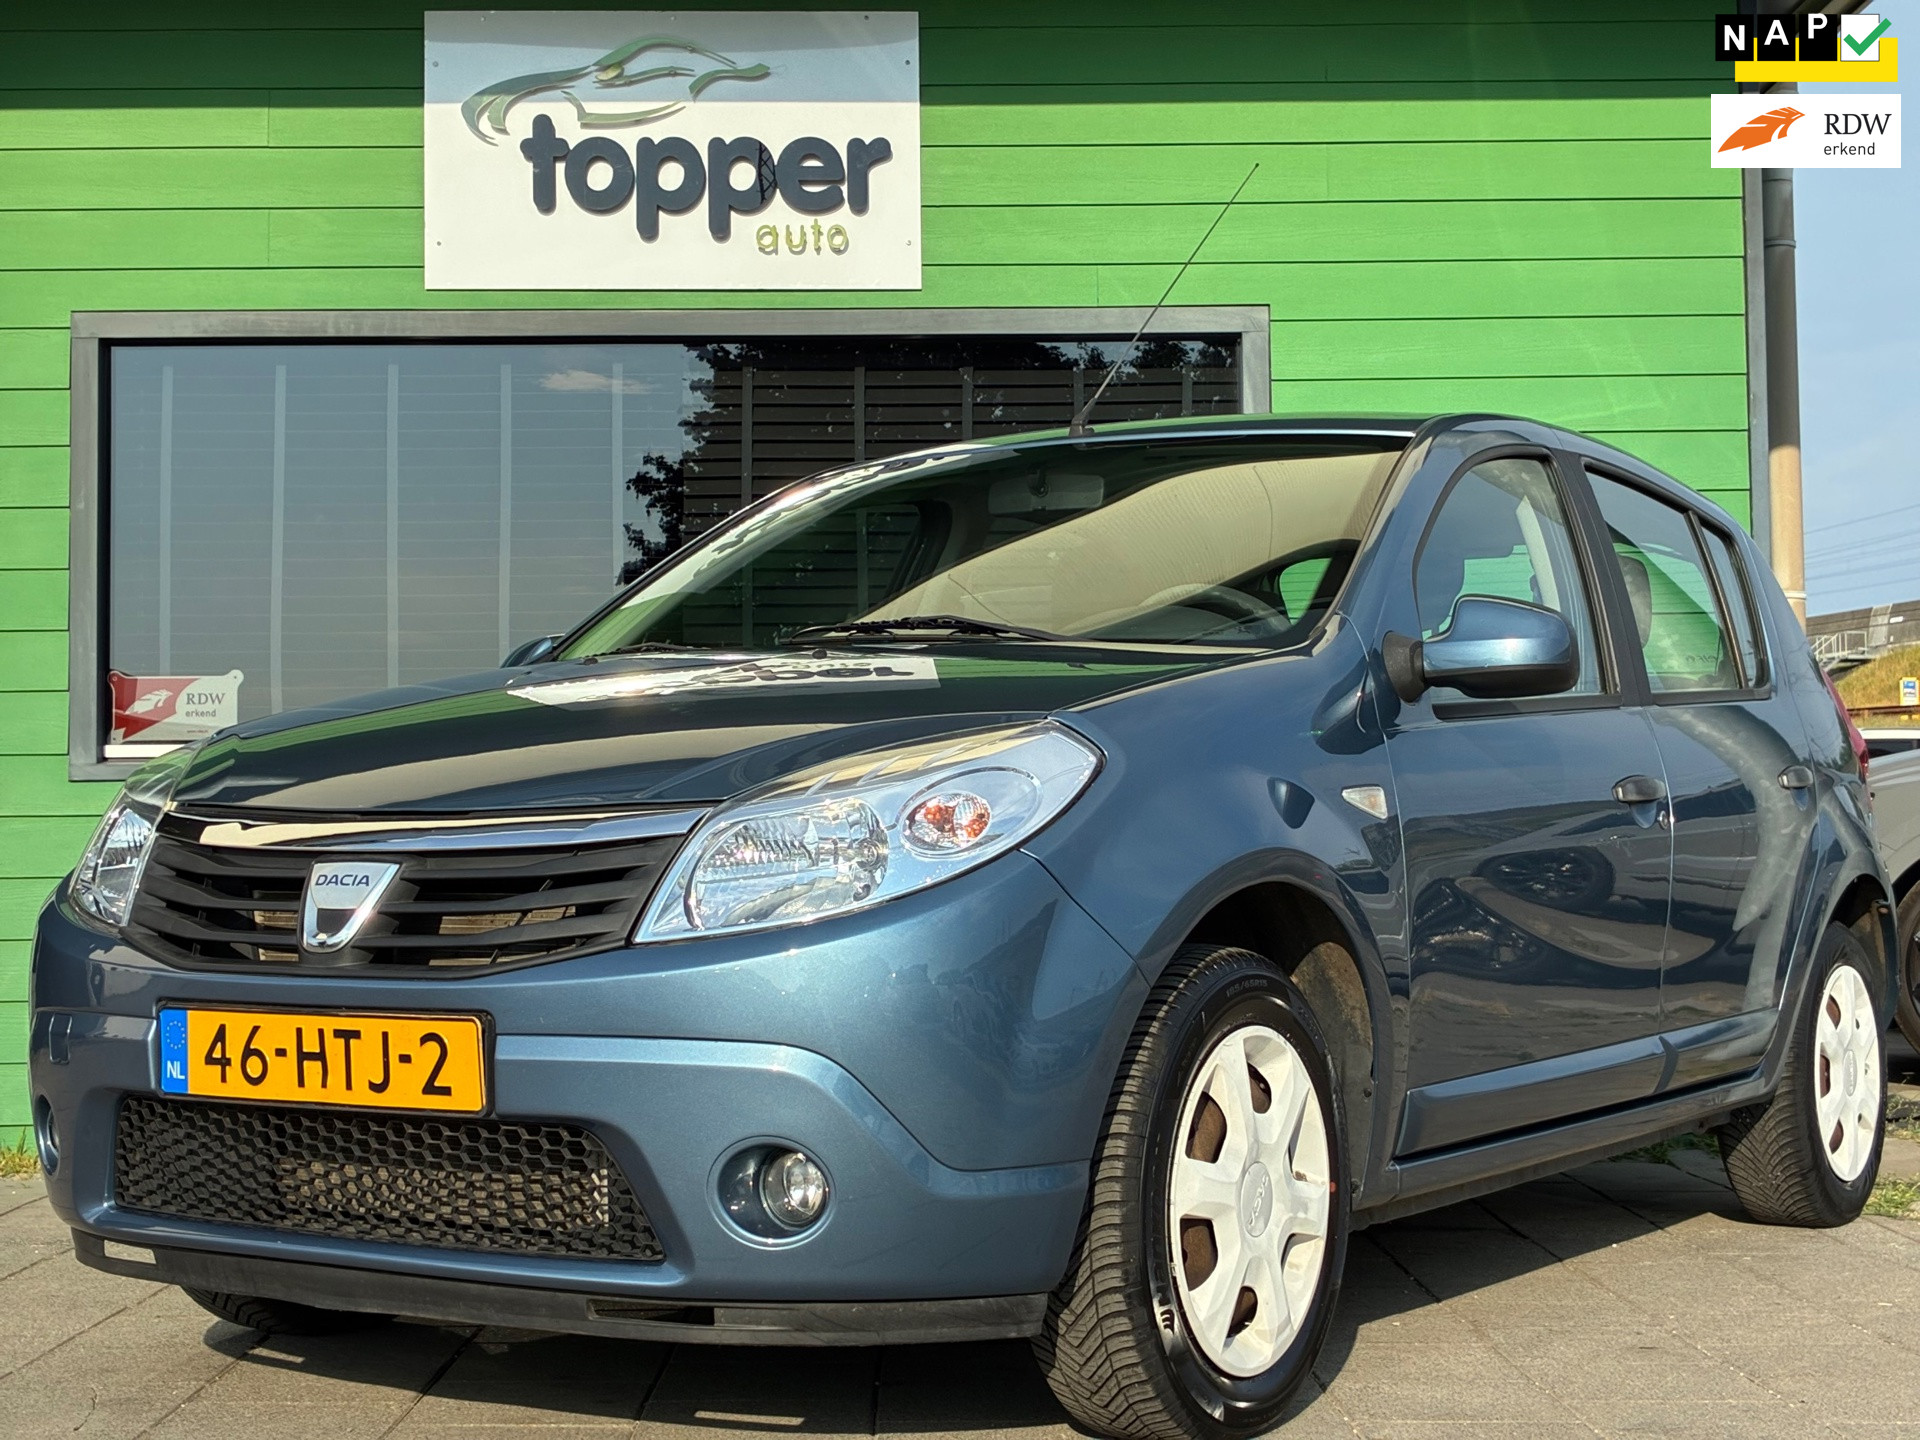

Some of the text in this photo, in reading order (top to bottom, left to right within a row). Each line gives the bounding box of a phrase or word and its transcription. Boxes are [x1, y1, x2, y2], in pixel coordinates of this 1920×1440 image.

[519, 113, 893, 243] topper
[755, 218, 850, 255] auto
[186, 692, 226, 705] RDW
[185, 708, 217, 718] erkend
[315, 874, 370, 887] DACIA
[203, 1022, 453, 1097] 46-HTJ-2
[166, 1060, 186, 1080] NL
